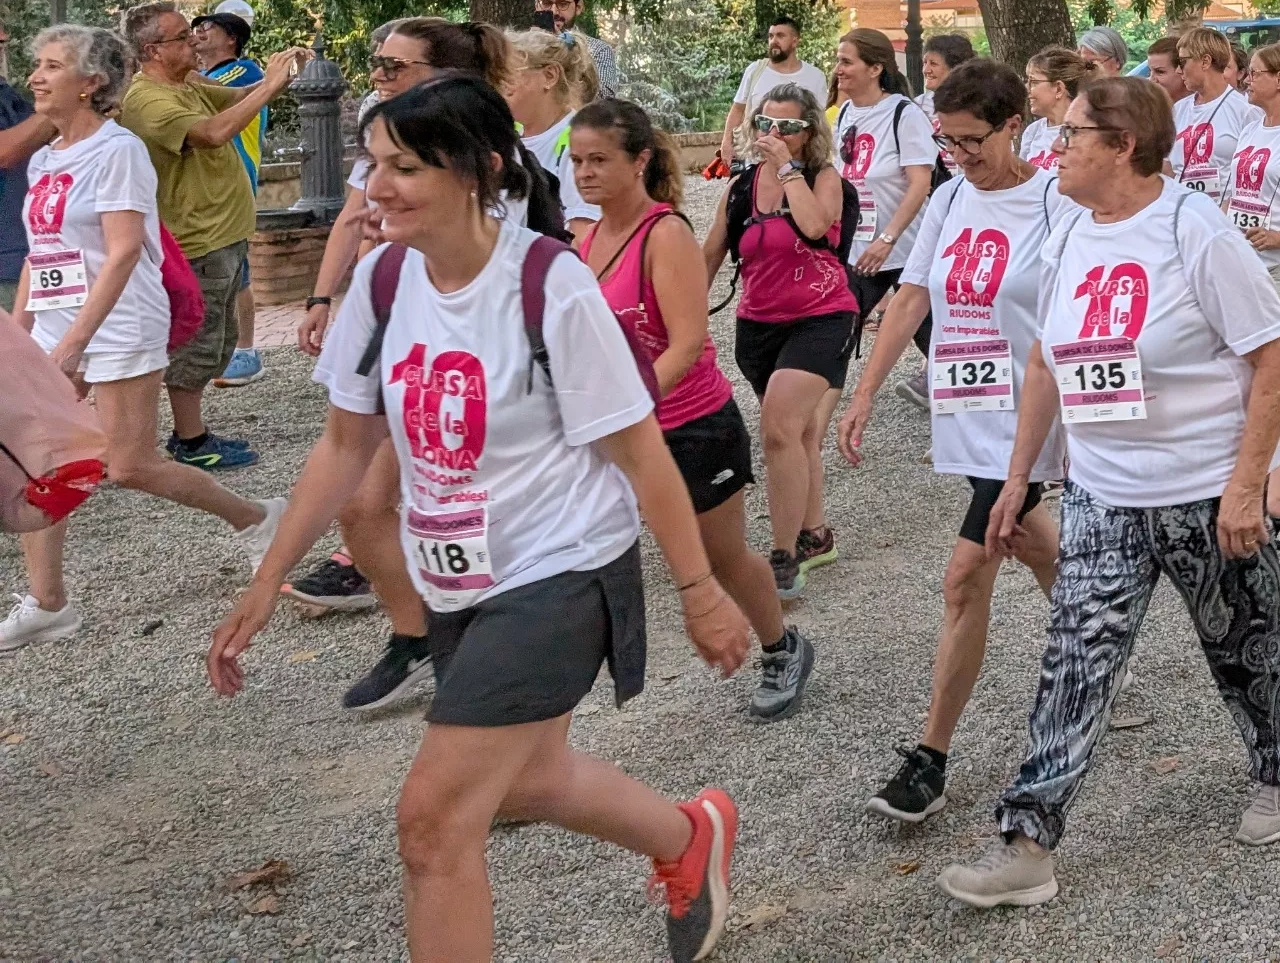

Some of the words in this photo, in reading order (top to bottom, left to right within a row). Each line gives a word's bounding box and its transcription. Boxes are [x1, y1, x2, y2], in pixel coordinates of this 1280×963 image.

[1233, 145, 1271, 190] 10
[1233, 211, 1260, 228] 133
[953, 241, 1007, 261] CURSA
[40, 268, 64, 289] 69
[941, 227, 1010, 305] 10
[1086, 278, 1147, 297] CURSA
[949, 308, 991, 320] RIUDOMS
[1073, 262, 1149, 341] 10
[1113, 306, 1132, 325] la
[947, 360, 997, 387] 132
[1074, 361, 1127, 391] 135
[386, 342, 487, 459] 10
[443, 411, 469, 436] la
[417, 539, 471, 575] 118
